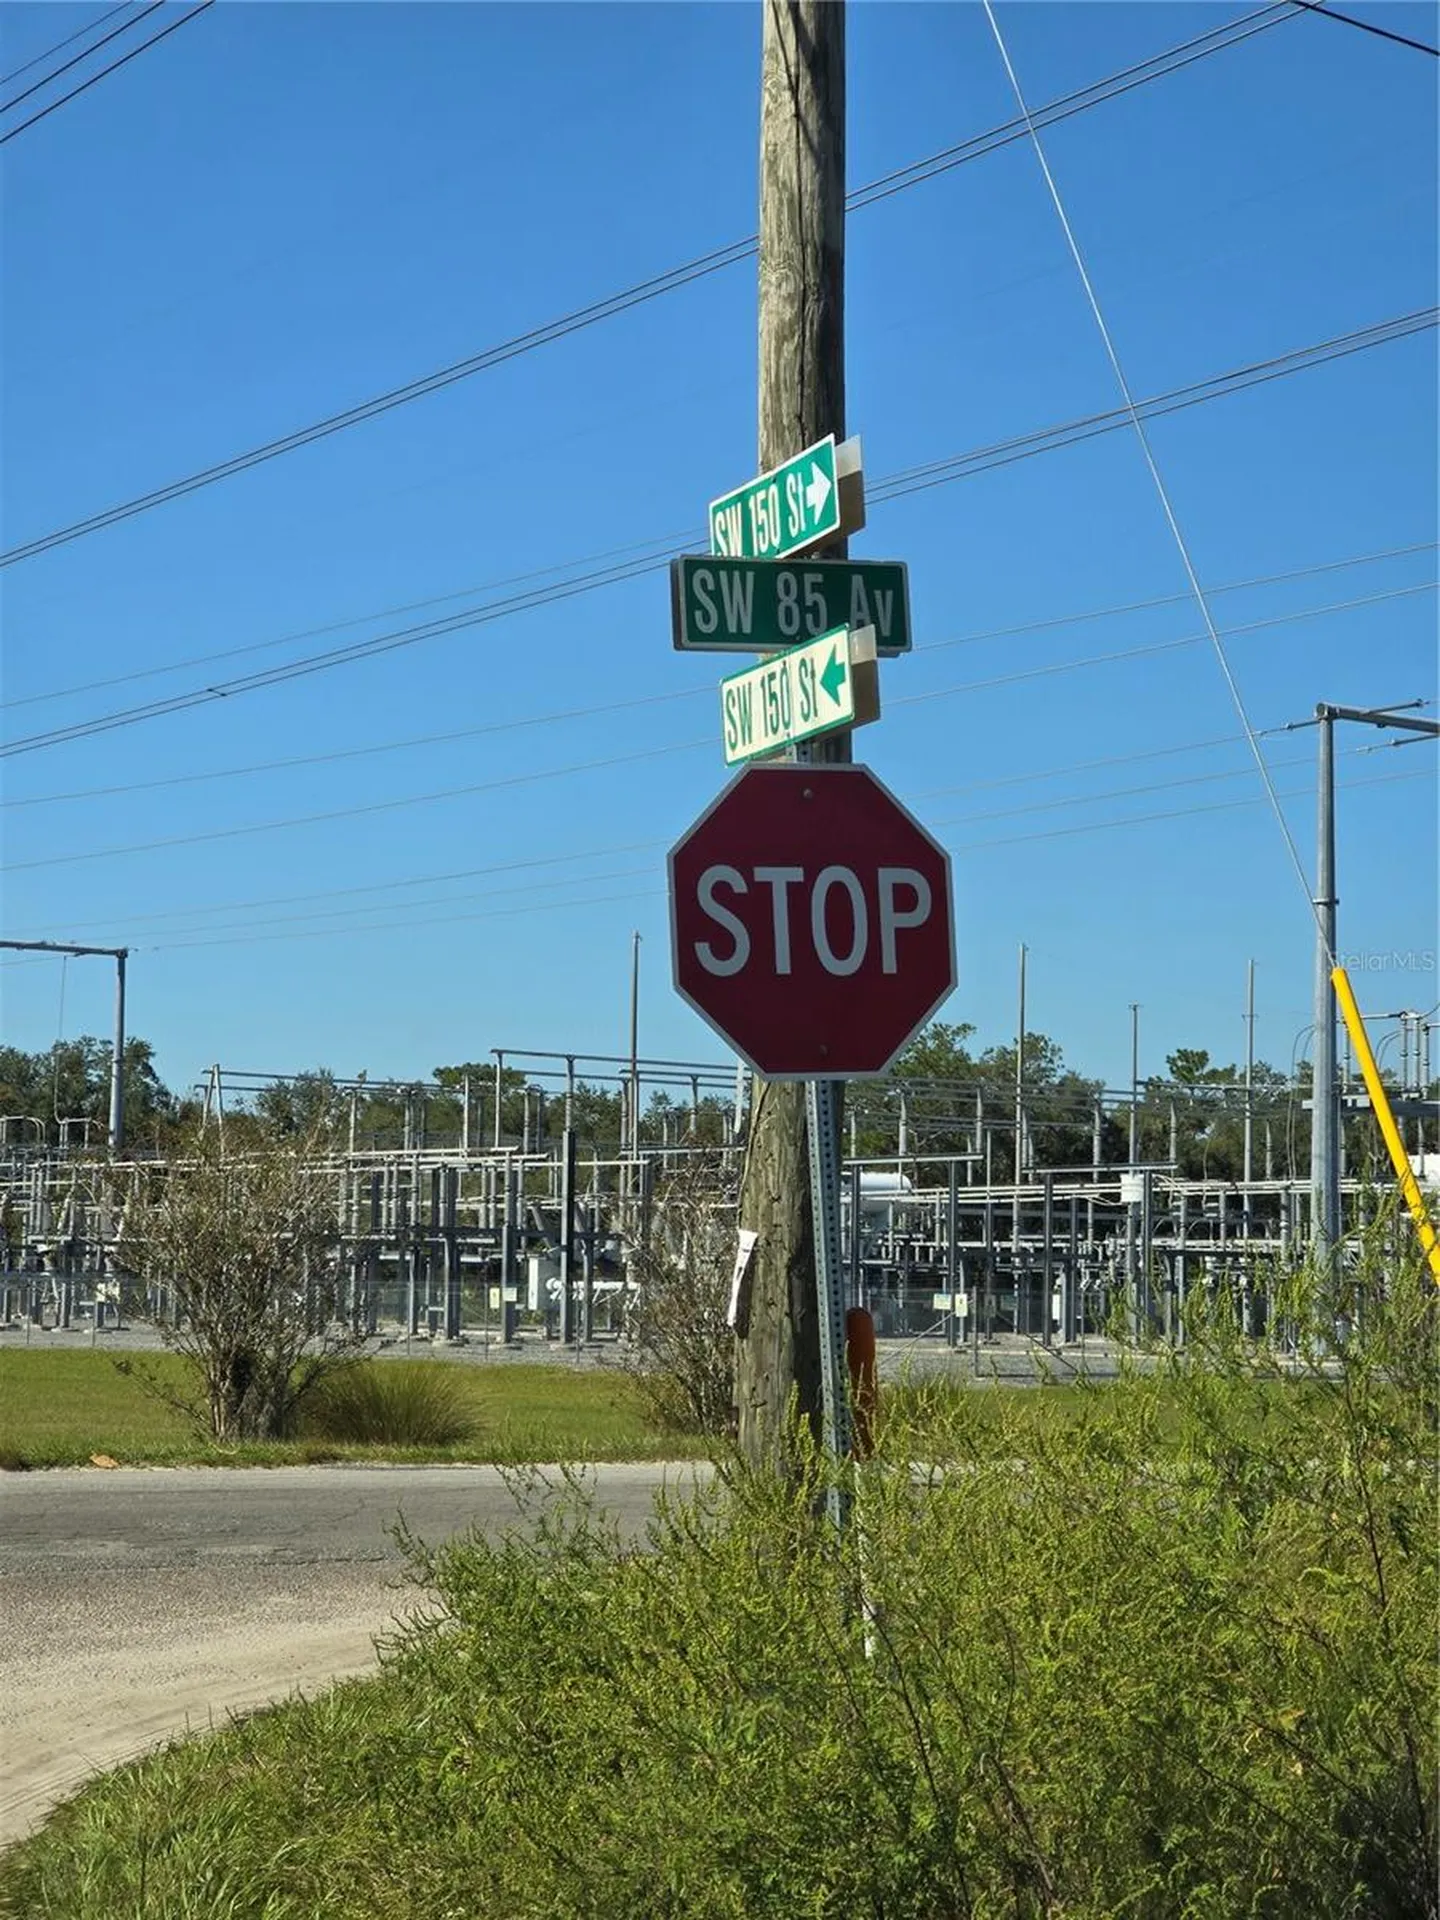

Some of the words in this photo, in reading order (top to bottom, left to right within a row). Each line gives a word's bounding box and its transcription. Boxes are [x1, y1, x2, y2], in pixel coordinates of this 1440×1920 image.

[715, 502, 742, 556] SW
[748, 483, 781, 556] 150
[786, 473, 806, 538] St
[692, 568, 755, 634] SW
[776, 571, 828, 636] 85
[849, 574, 893, 637] Av
[726, 682, 752, 751] SW
[760, 664, 791, 738] 150
[799, 657, 818, 722] St
[694, 864, 932, 977] STOP
